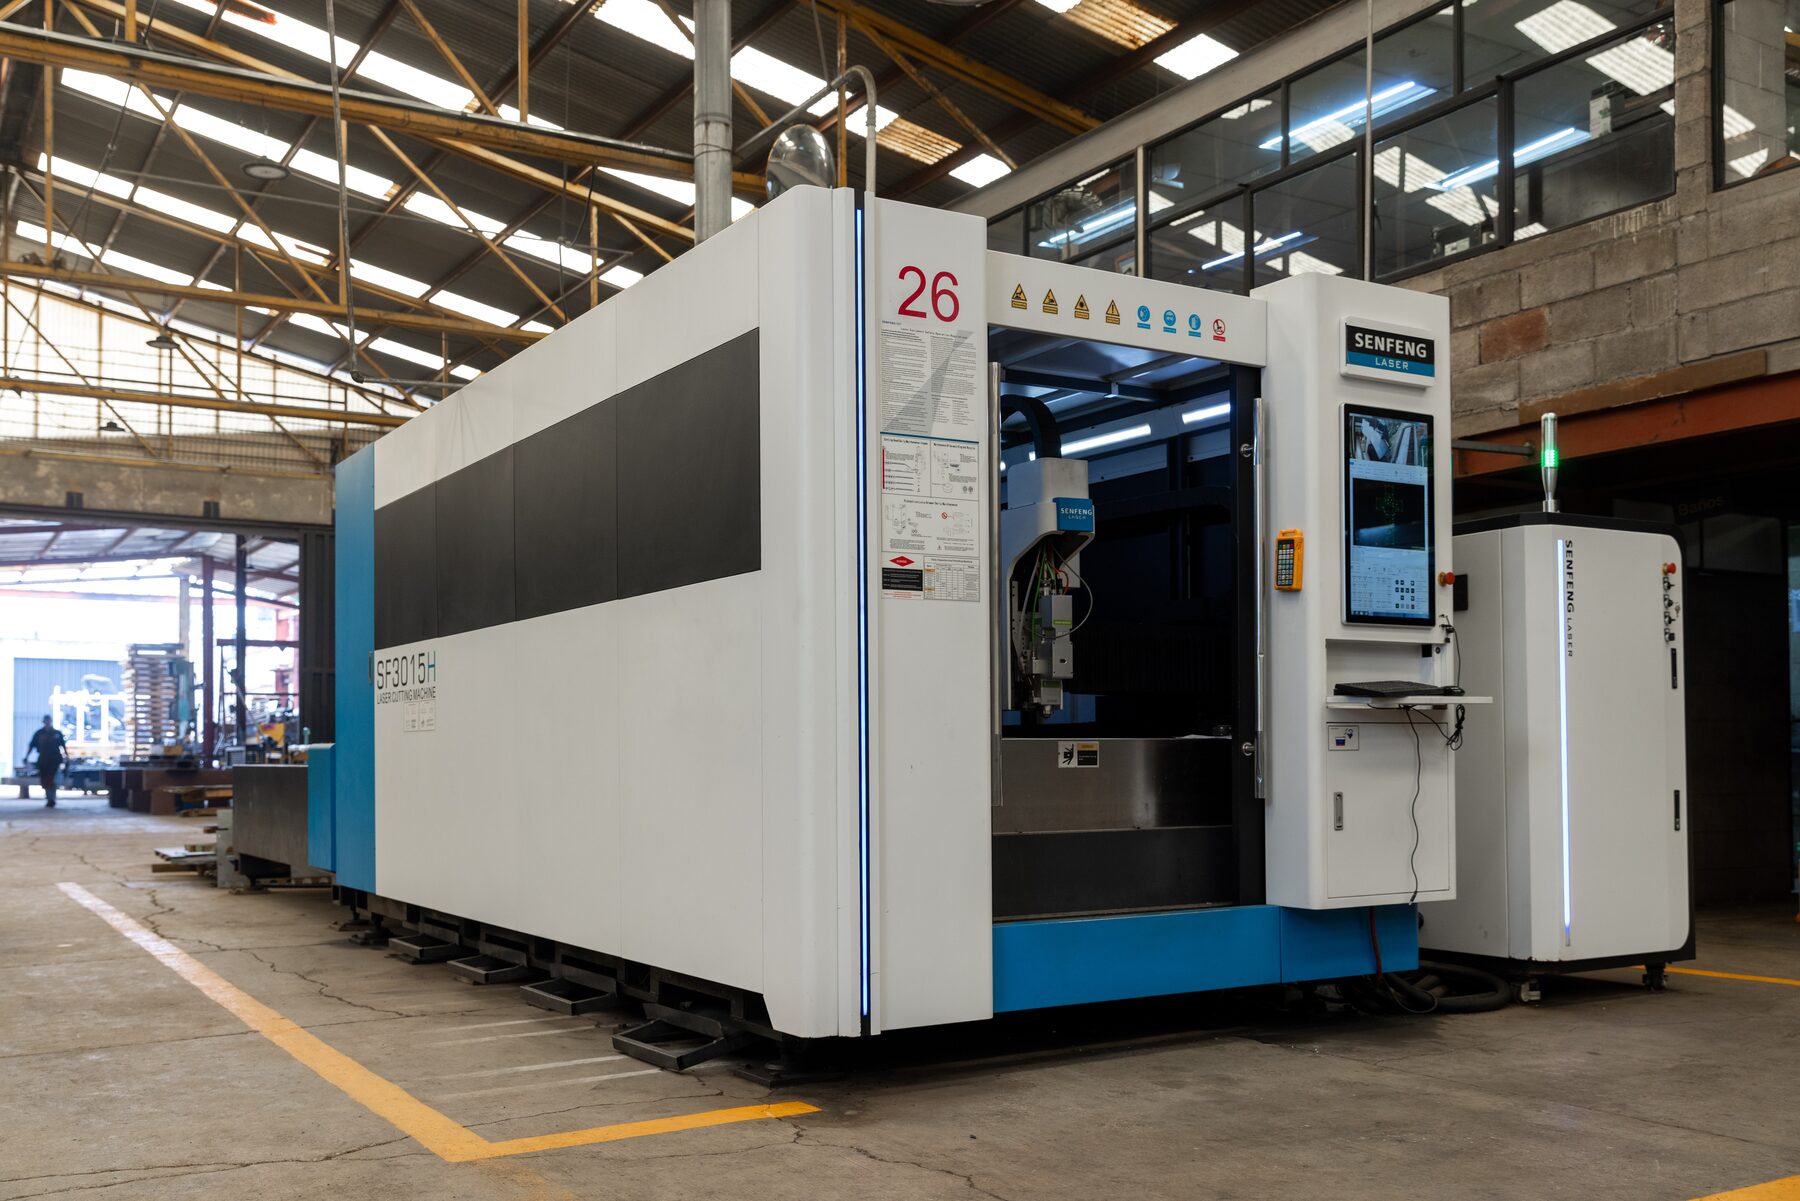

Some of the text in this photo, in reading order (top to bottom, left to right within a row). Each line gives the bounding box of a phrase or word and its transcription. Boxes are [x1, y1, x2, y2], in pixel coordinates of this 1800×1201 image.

[898, 265, 960, 323] 26
[1355, 332, 1427, 358] SENFENG
[1375, 357, 1409, 370] LASER
[1060, 507, 1093, 515] SENFENG
[1565, 540, 1574, 613] SENFENG
[377, 650, 436, 690] SF3015H
[377, 686, 436, 704] LASER CUTTING MACHINE
